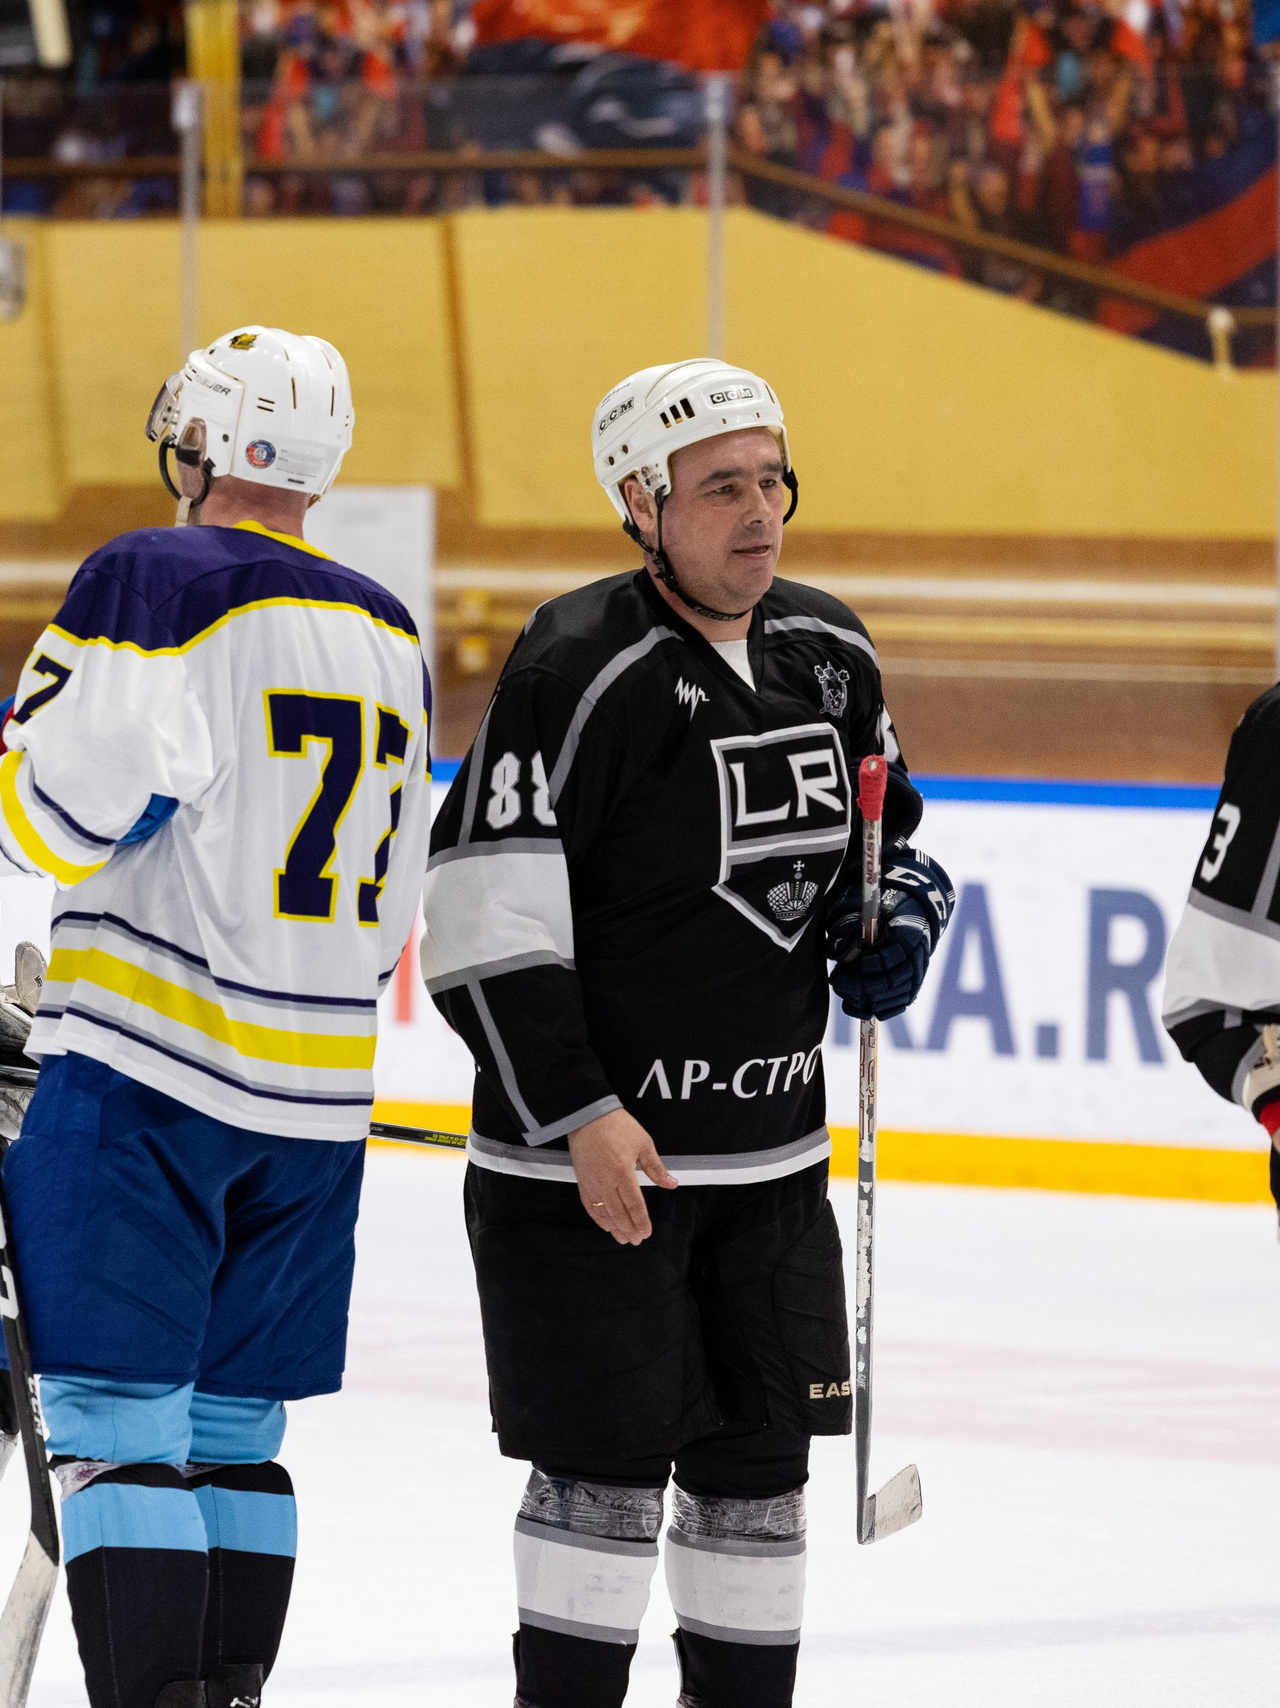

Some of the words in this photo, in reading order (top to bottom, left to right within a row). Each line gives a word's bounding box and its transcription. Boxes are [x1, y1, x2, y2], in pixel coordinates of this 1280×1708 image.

[709, 387, 754, 404] CCM
[599, 398, 634, 431] CCM
[729, 748, 845, 827] LR
[262, 688, 413, 928] 77
[809, 1381, 853, 1399] EAS
